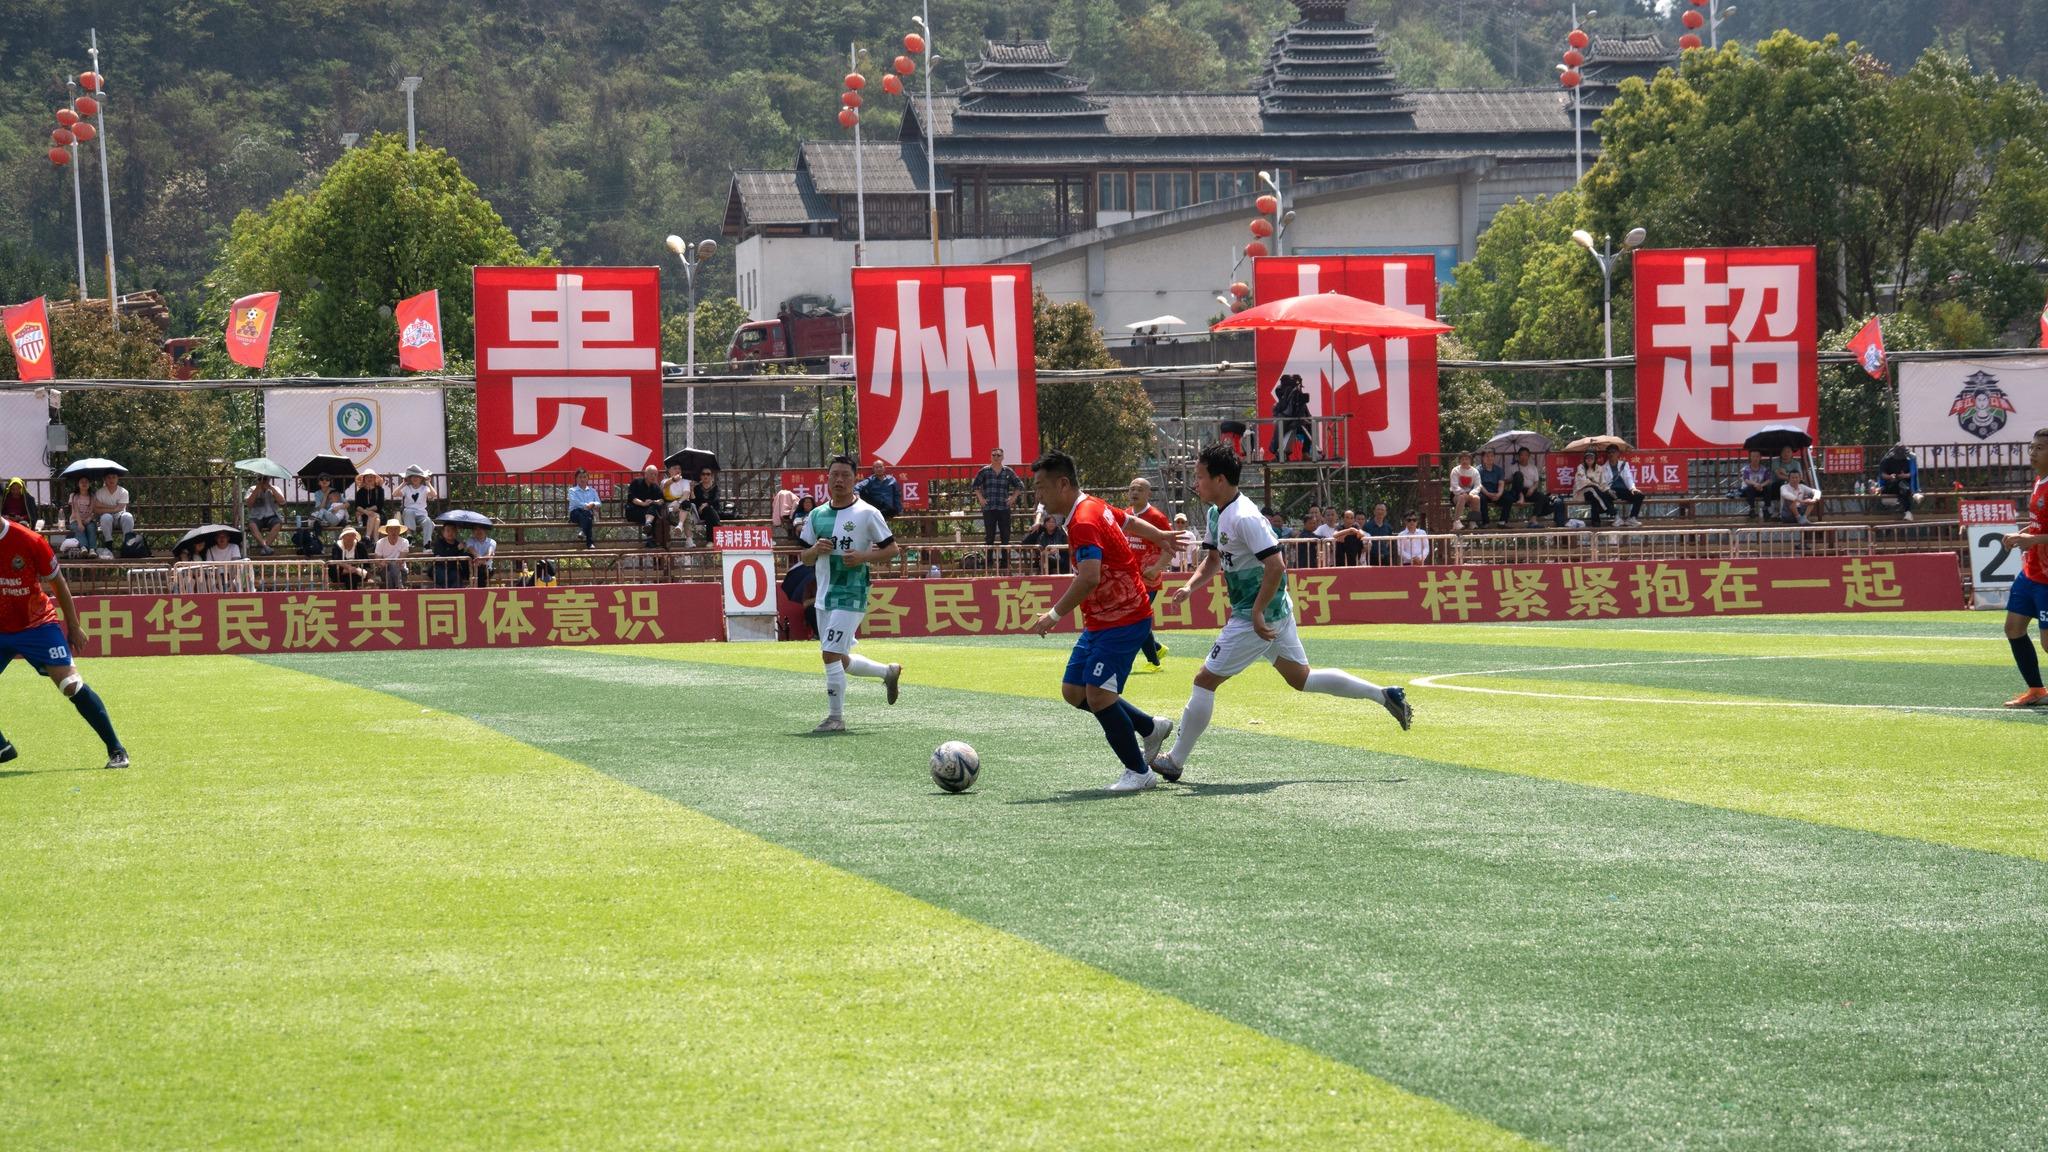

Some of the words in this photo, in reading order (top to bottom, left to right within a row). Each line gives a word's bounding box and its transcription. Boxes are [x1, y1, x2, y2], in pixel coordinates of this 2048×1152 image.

[486, 273, 657, 475] 贵
[870, 274, 1023, 464] 州
[1271, 263, 1426, 458] 村
[1652, 257, 1809, 445] 超
[1960, 503, 2015, 522] 香港警察男子队
[715, 529, 770, 548] 寿洞村男子队
[1978, 532, 2016, 583] 2
[731, 559, 768, 608] 0
[860, 558, 1905, 635] 各民族石籽一样紧紧抱在一起
[56, 589, 665, 656] 中华民族共同体意识
[827, 629, 844, 643] 87
[48, 645, 68, 659] 80
[1092, 661, 1105, 677] 8
[1210, 643, 1221, 660] 8
